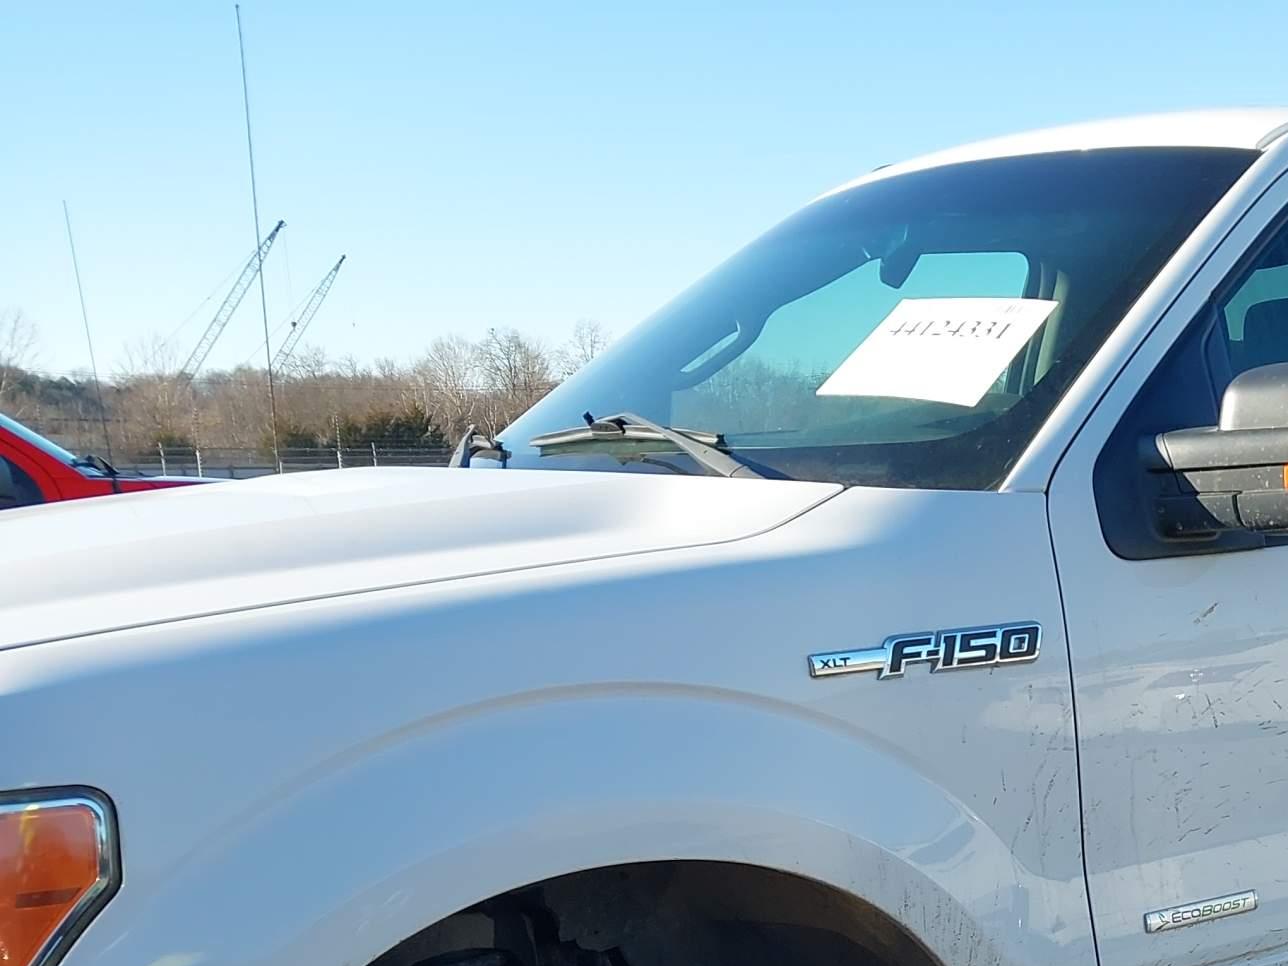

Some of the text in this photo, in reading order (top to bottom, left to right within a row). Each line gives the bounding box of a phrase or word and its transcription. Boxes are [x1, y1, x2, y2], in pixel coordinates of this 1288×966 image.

[889, 319, 1012, 340] 44124331
[819, 620, 1042, 680] XLT F-150
